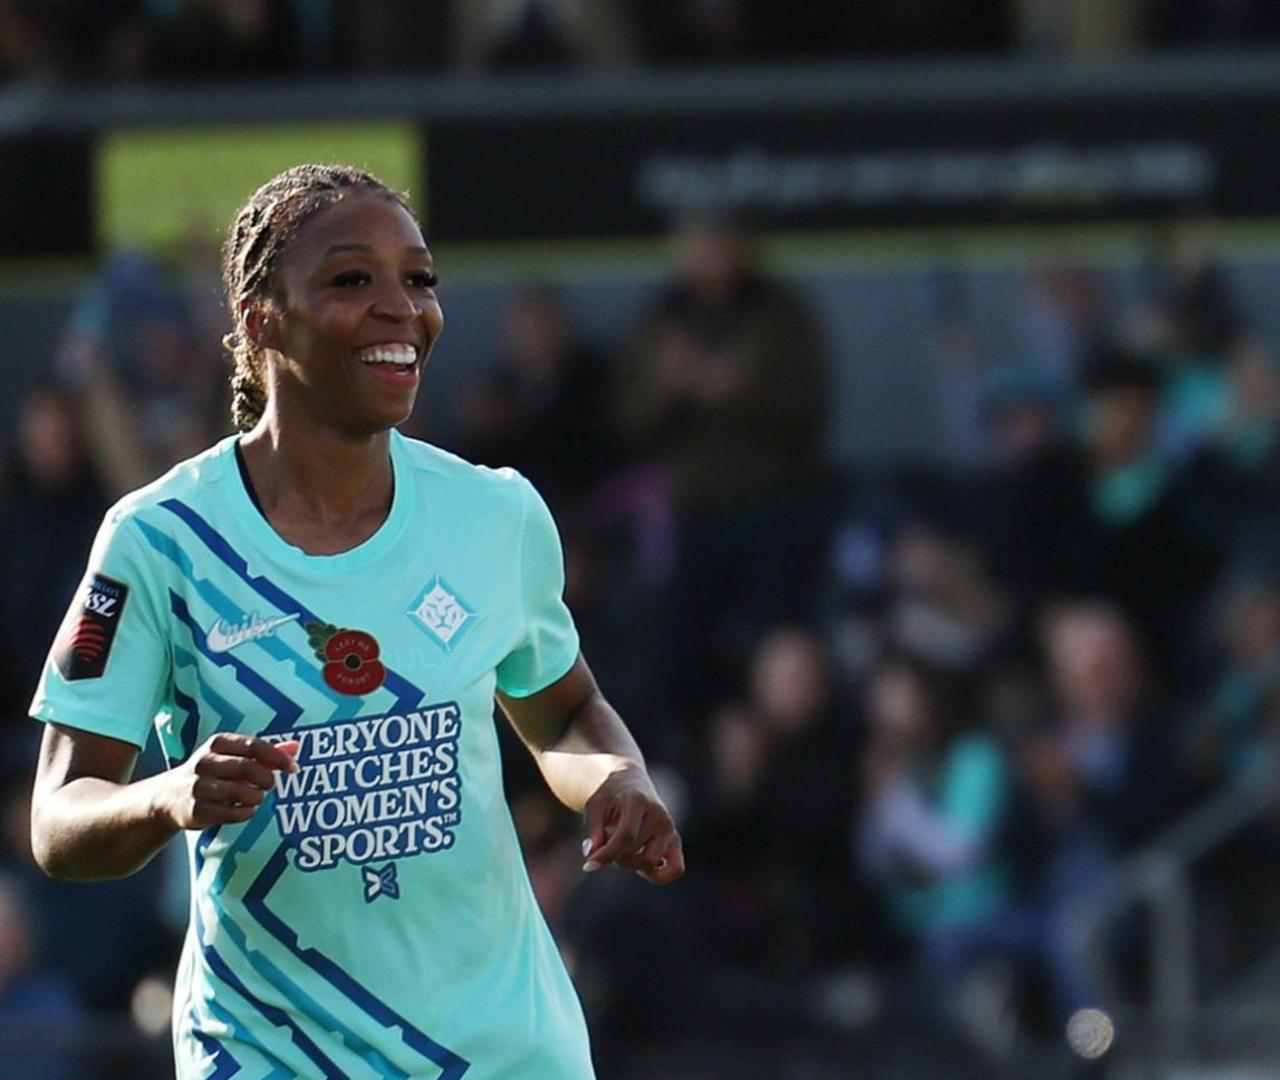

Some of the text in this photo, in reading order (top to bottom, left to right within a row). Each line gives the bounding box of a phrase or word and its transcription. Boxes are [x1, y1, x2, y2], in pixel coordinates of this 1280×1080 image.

[81, 587, 118, 617] SL
[262, 705, 459, 761] VERYONE
[272, 742, 456, 800] WATCHES
[275, 777, 459, 835] WOMEN'S
